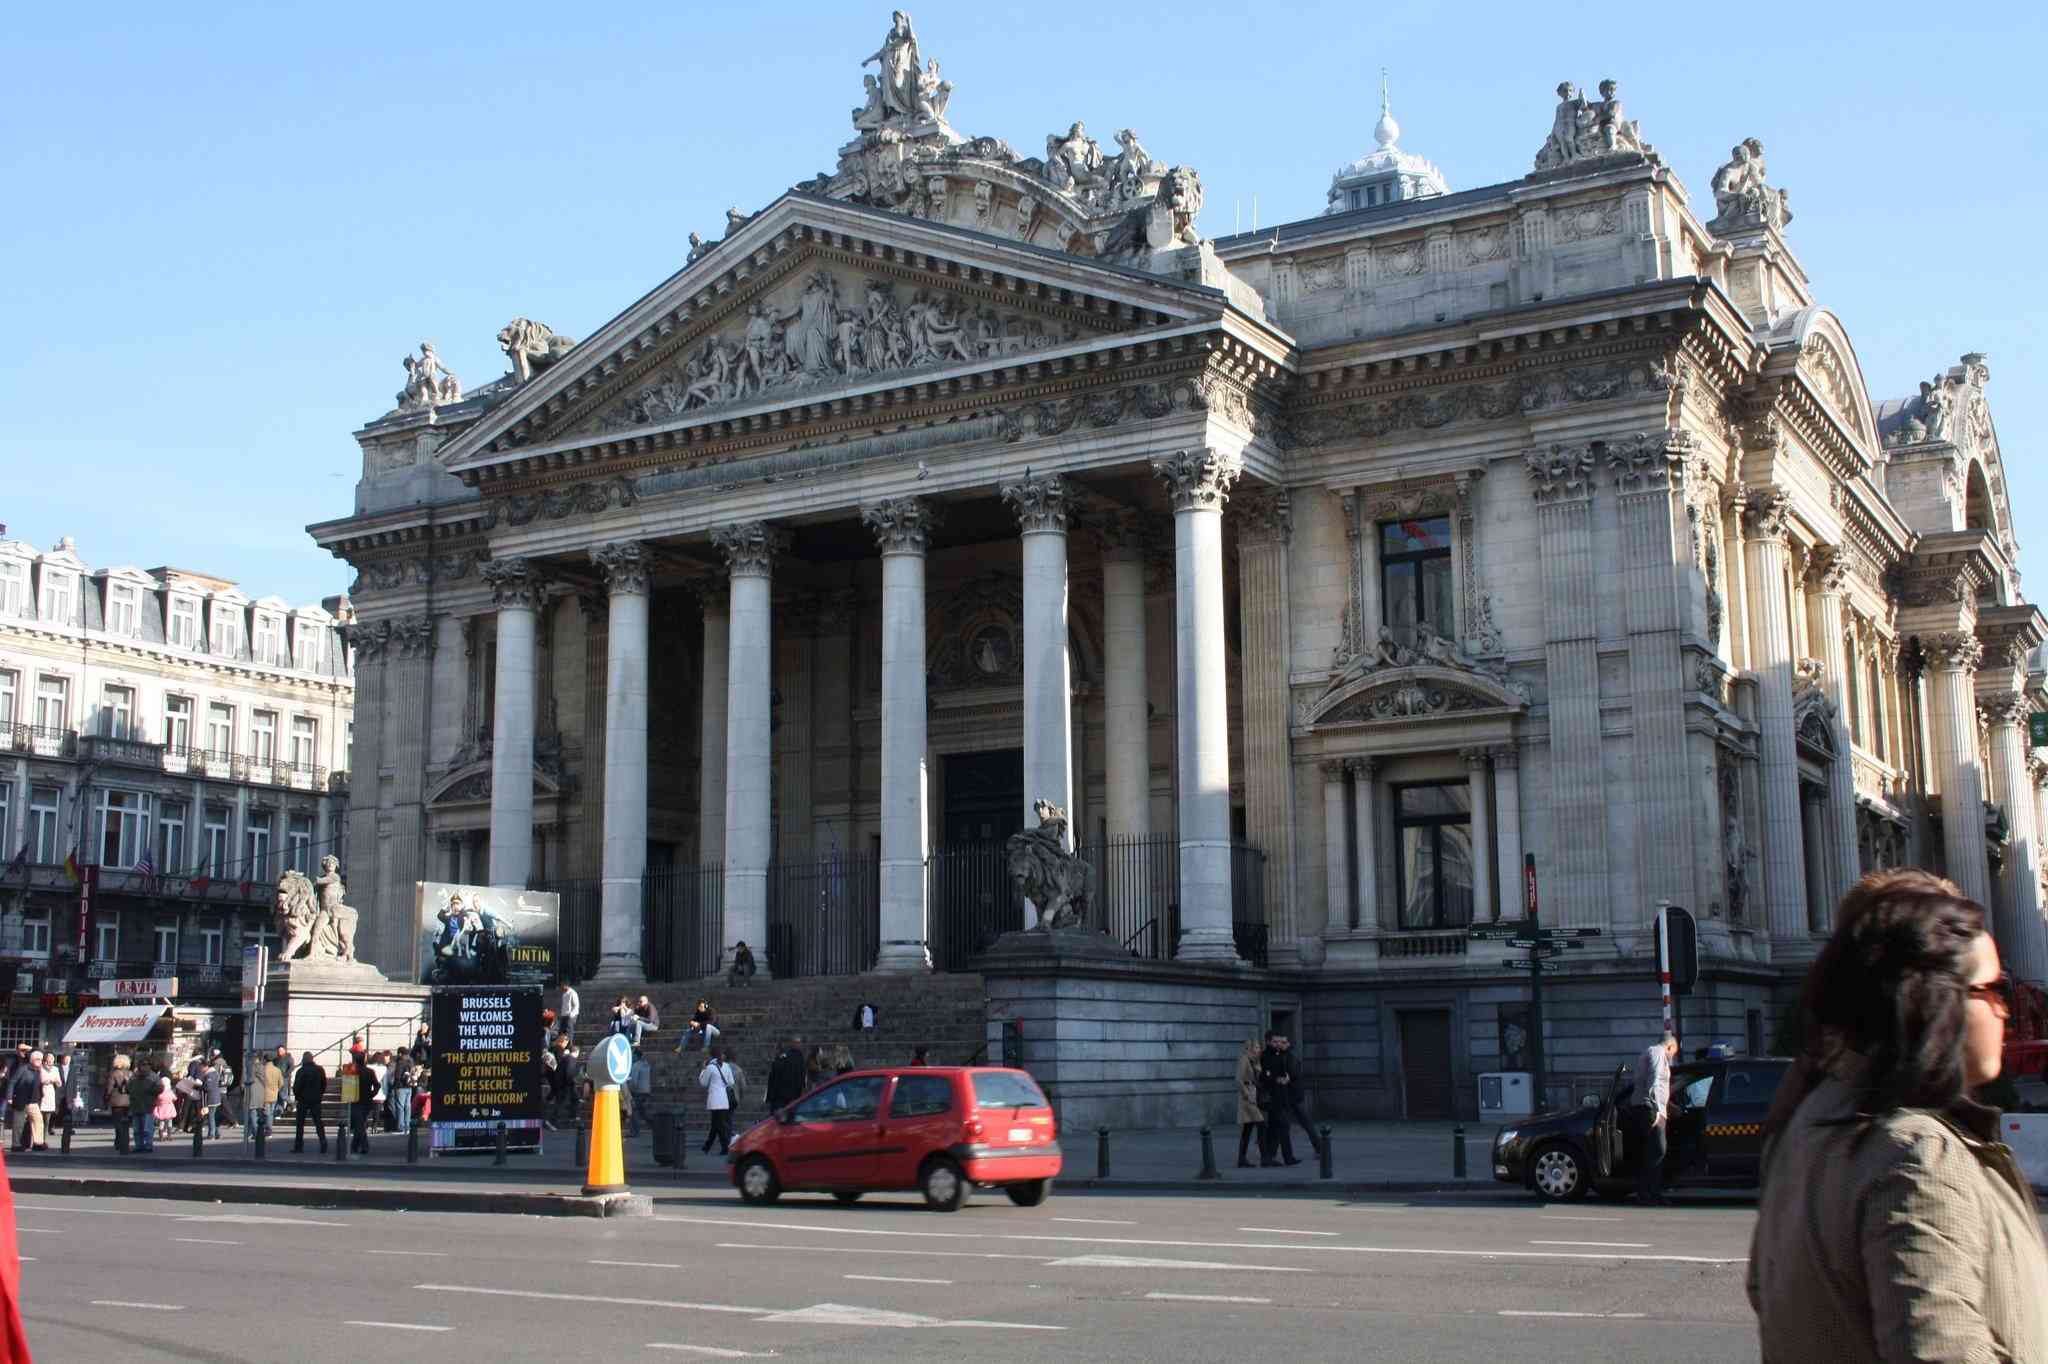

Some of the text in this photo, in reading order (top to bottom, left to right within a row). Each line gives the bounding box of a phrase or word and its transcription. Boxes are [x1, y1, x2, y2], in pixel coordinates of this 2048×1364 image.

[78, 867, 89, 963] INDIAN
[512, 948, 550, 962] TINTIN
[462, 997, 511, 1009] BRUSSELS
[80, 1013, 149, 1028] Newsweek
[460, 1011, 513, 1022] WELCOMES
[458, 1024, 514, 1036] THE WORLD
[460, 1038, 513, 1049] PREMIERE:
[468, 1051, 530, 1063] ADVENTURES
[460, 1065, 512, 1077] OF TINTIN:
[458, 1079, 514, 1090] THE SECRET
[443, 1092, 528, 1105] OF THE UNICORN"
